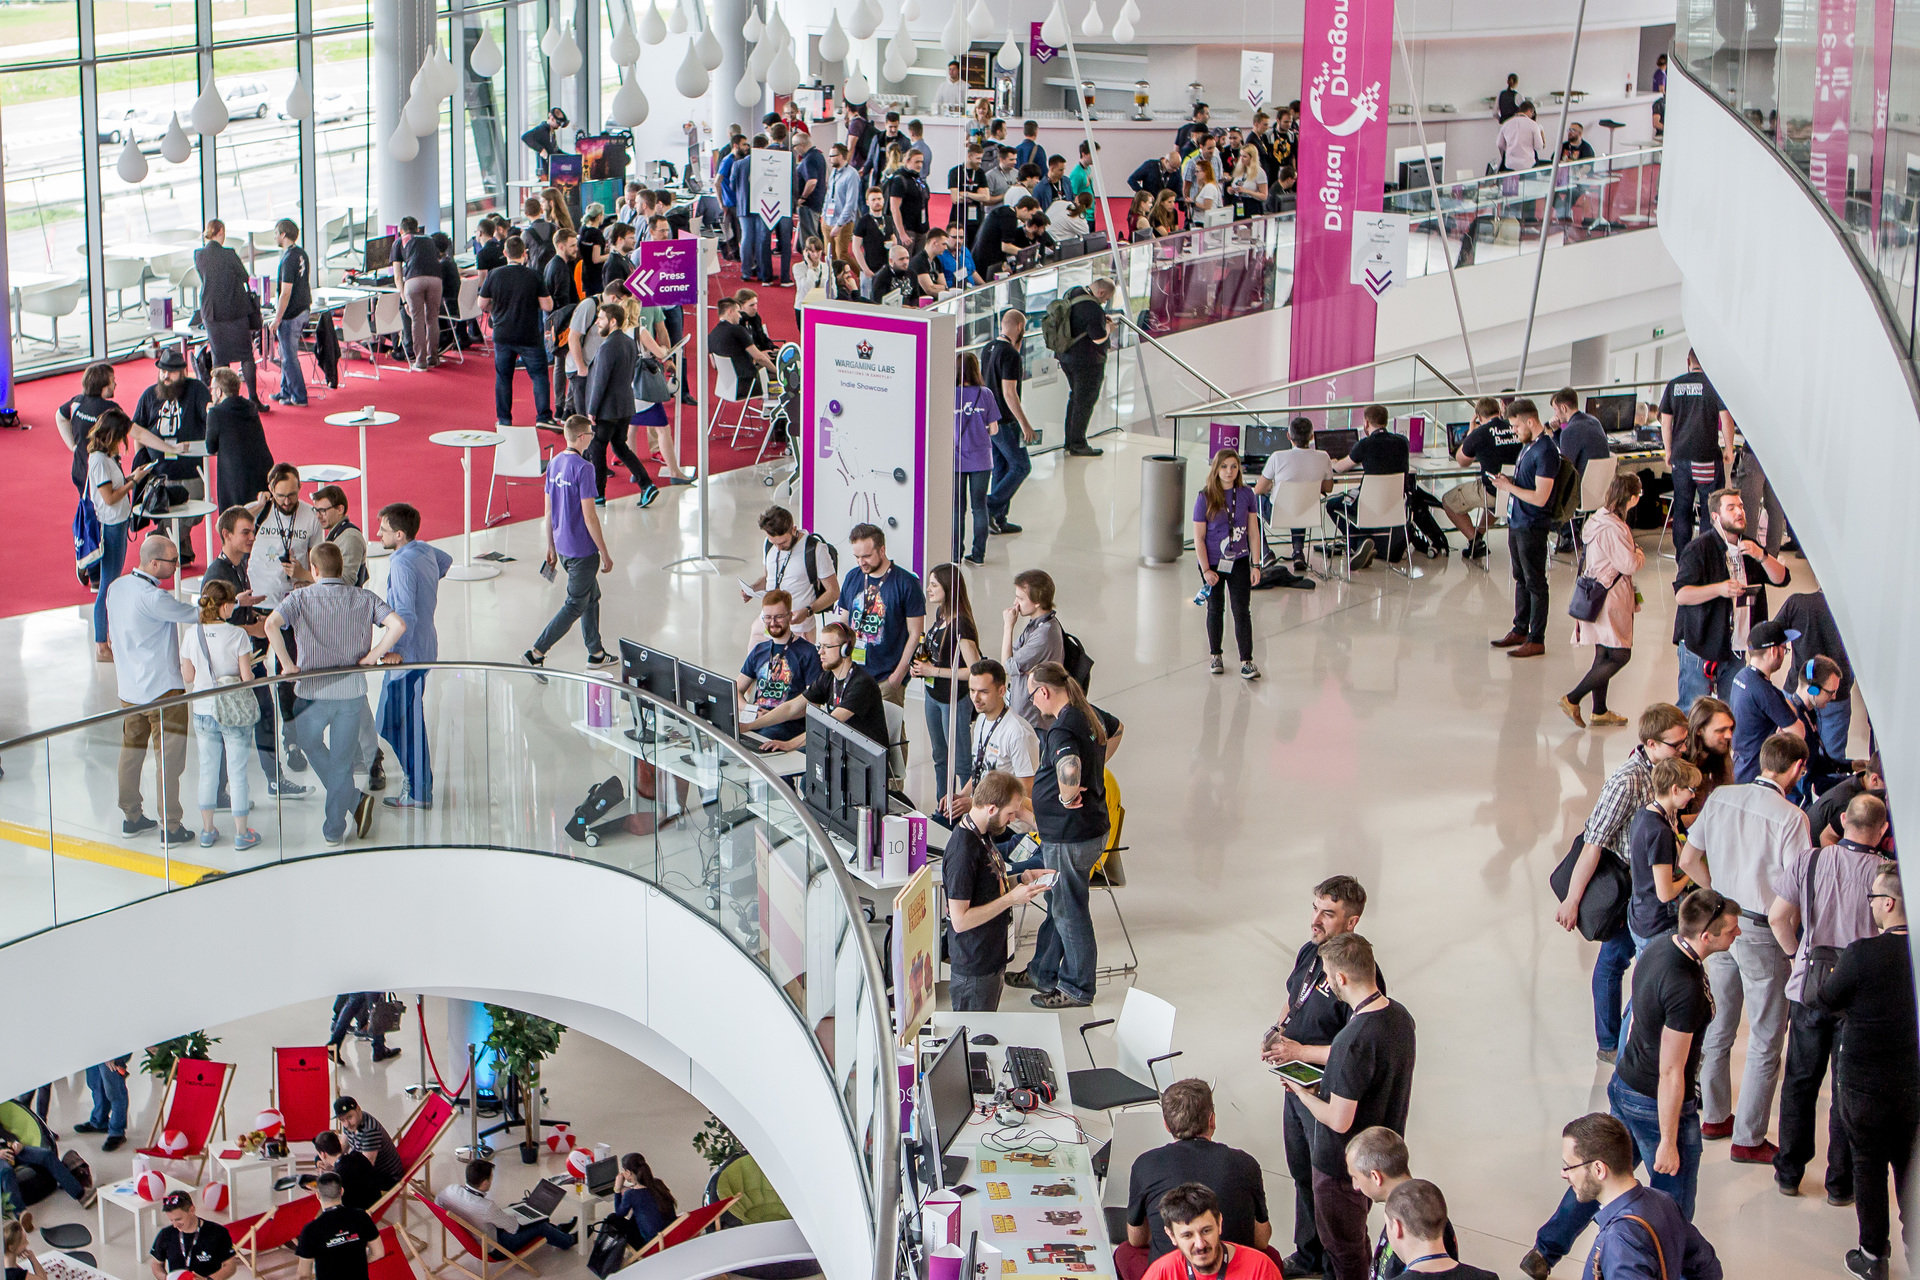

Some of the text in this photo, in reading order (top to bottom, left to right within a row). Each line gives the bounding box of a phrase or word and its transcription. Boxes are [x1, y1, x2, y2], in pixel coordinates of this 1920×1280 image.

[659, 272, 686, 280] Press
[659, 284, 690, 293] corner
[834, 359, 896, 373] WARGAMING LABS
[840, 380, 889, 392] Indie Showcase
[1223, 436, 1239, 446] 20
[888, 840, 905, 855] 10
